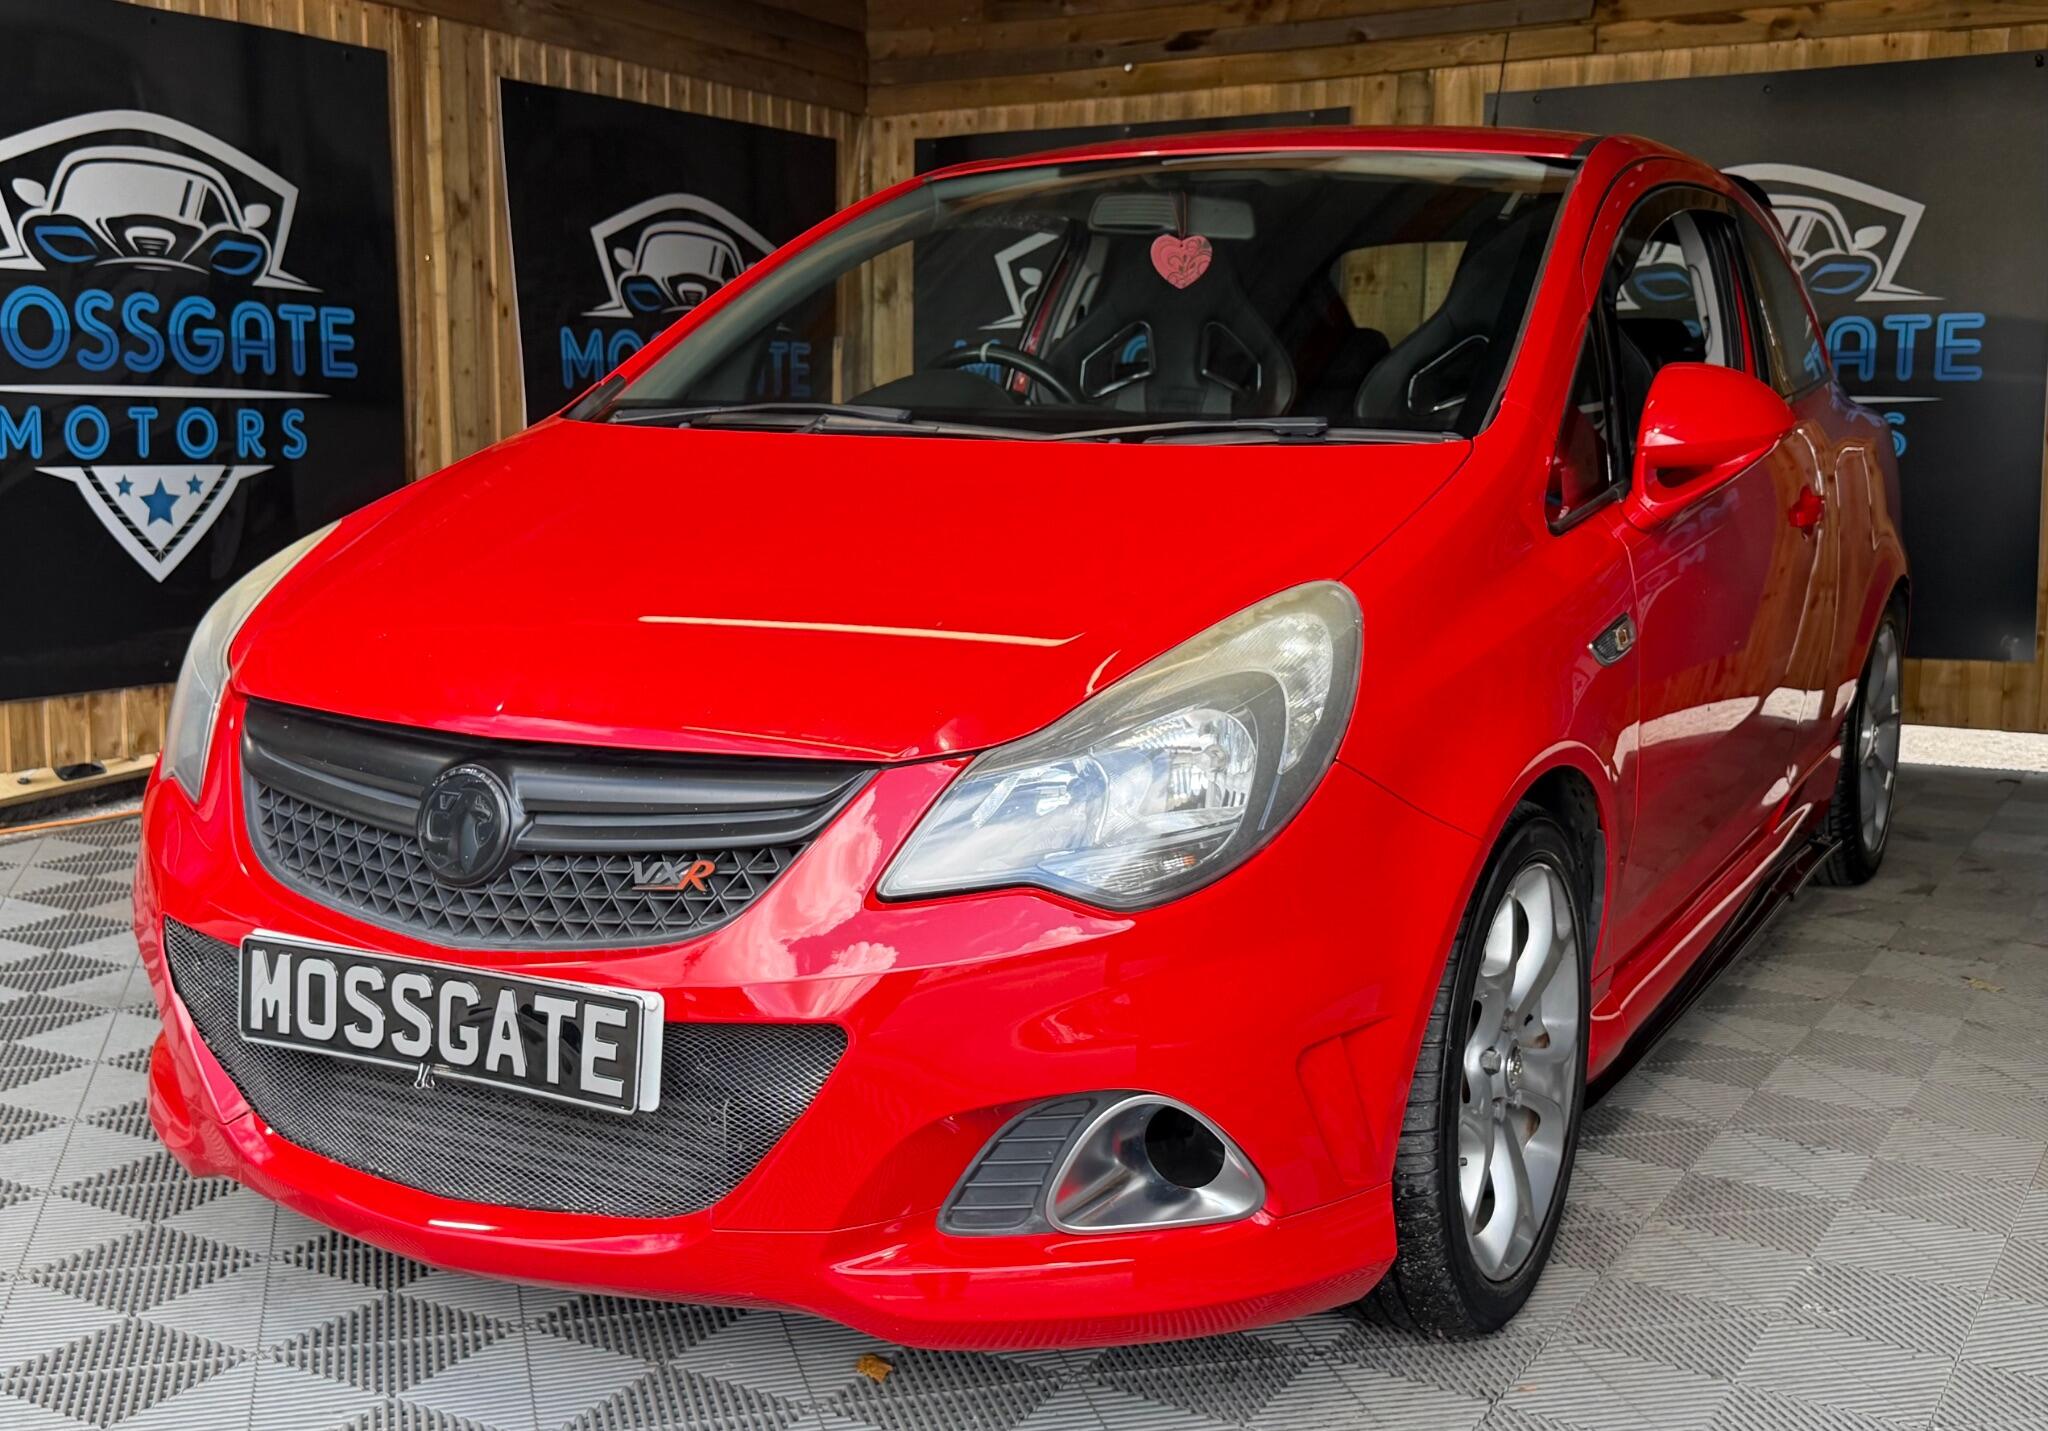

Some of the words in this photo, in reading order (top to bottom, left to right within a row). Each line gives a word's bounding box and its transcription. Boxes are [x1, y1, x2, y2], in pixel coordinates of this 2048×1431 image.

[0, 405, 308, 460] MOTORS
[632, 859, 715, 892] VXR
[250, 948, 629, 1099] MOSSGATE
